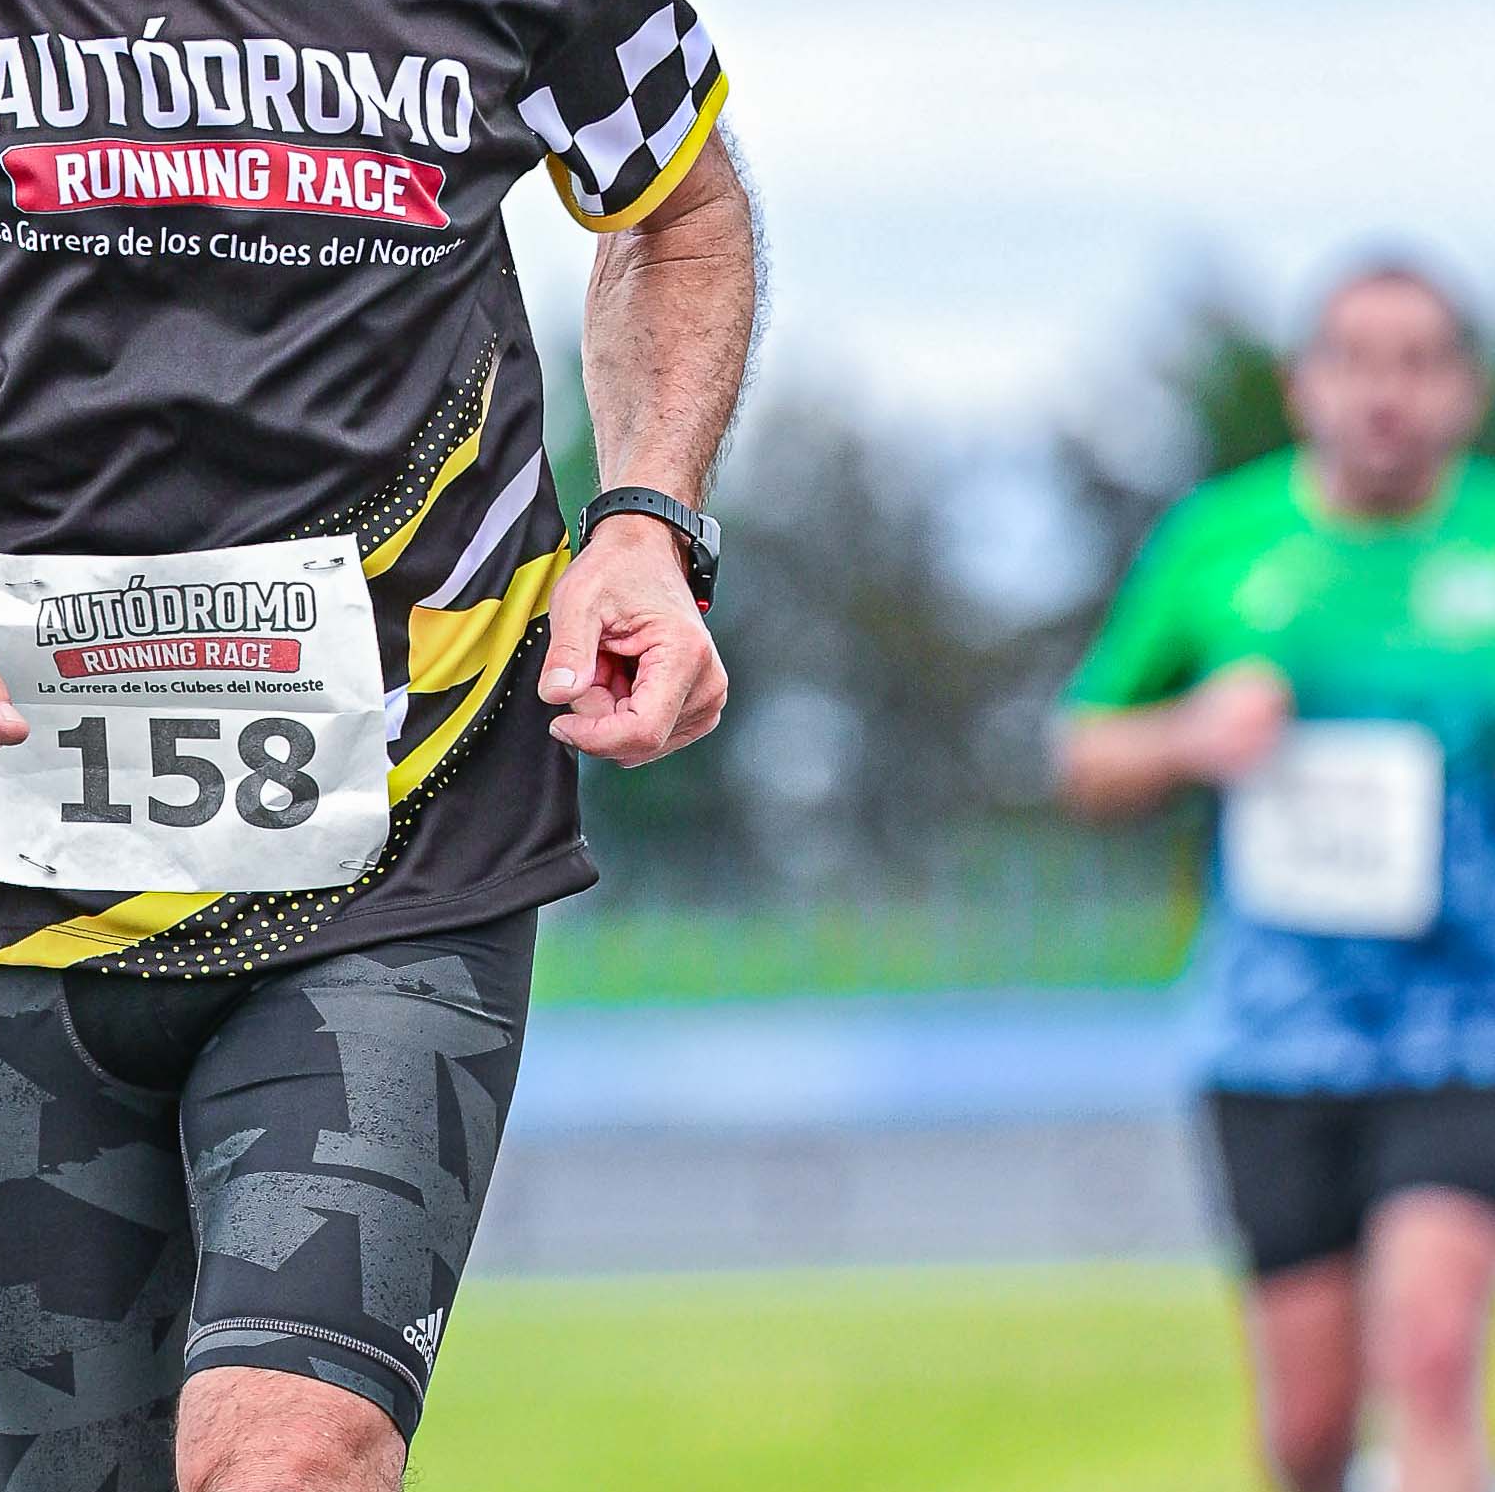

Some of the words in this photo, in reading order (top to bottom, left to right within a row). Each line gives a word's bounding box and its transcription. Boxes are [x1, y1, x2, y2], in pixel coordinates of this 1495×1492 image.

[55, 147, 270, 206] RUNNING
[284, 159, 411, 216] RACE
[16, 220, 110, 256] Carrera
[118, 227, 153, 256] de
[160, 227, 201, 256] los
[208, 233, 311, 267] Clubes
[318, 237, 365, 267] del
[36, 575, 316, 647] AUTÓDROMO
[38, 682, 55, 694] La
[60, 682, 118, 694] Carrera
[121, 681, 141, 694] de
[145, 681, 167, 694] los
[170, 681, 223, 694] Clubes
[226, 680, 251, 694] del
[254, 679, 324, 694] Noroeste
[82, 641, 197, 674] RUNNING
[205, 642, 272, 669] RACE
[57, 716, 320, 830] 158
